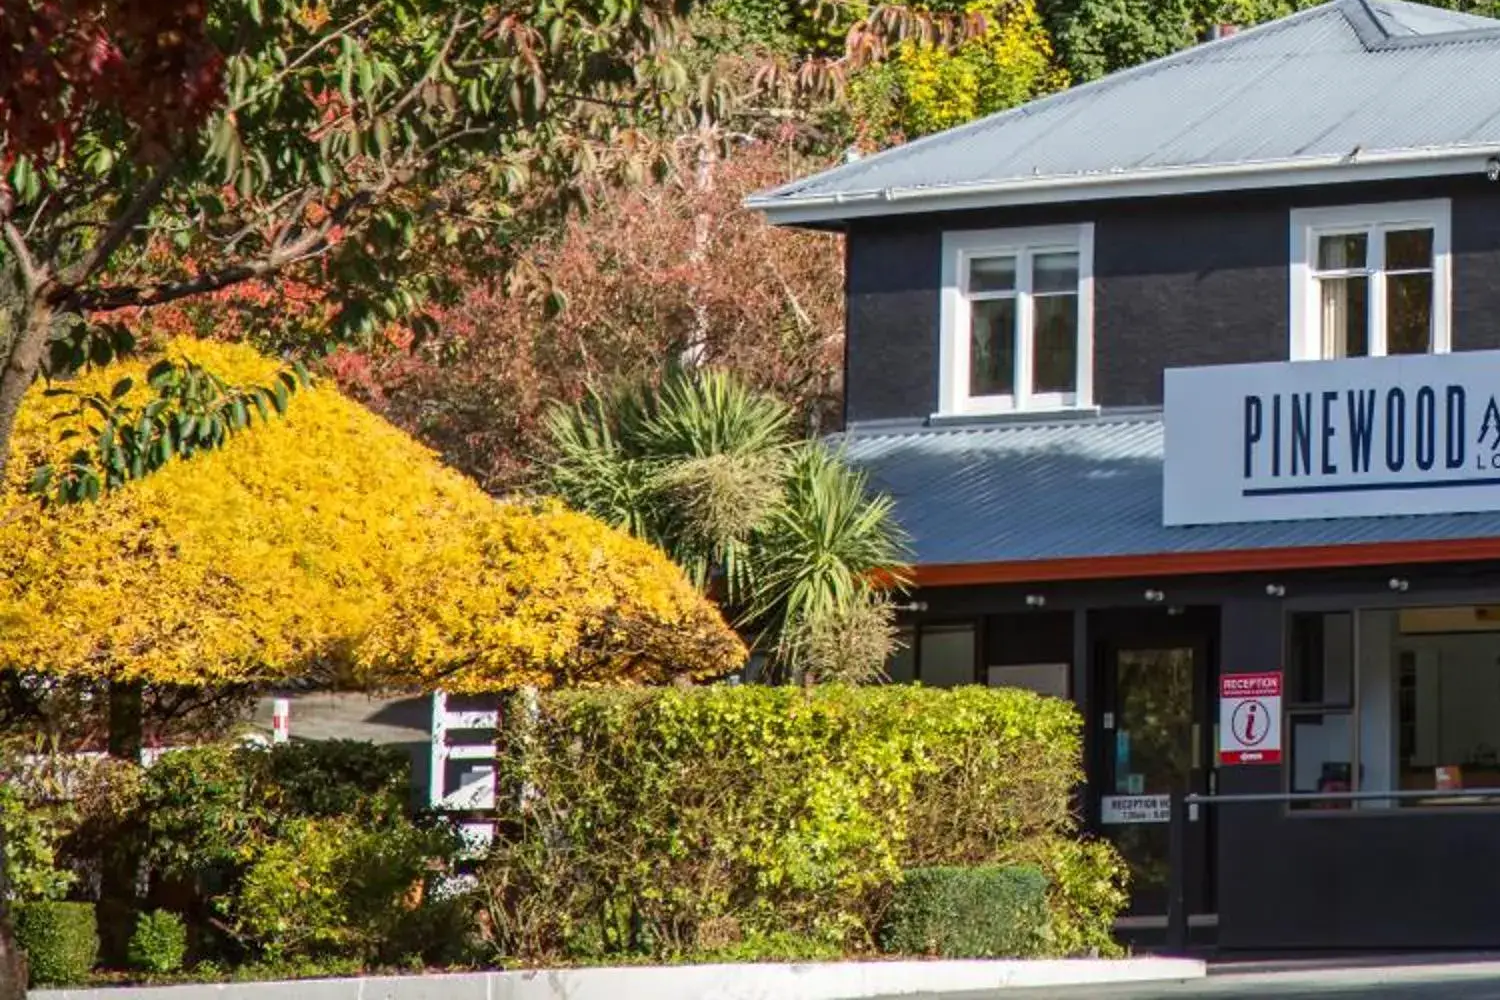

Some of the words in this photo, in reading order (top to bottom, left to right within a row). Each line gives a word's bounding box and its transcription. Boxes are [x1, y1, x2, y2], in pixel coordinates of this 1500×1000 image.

[1244, 385, 1466, 478] PINEWOOD
[1223, 678, 1279, 689] RECEPTION
[1111, 799, 1157, 809] RECEPTION
